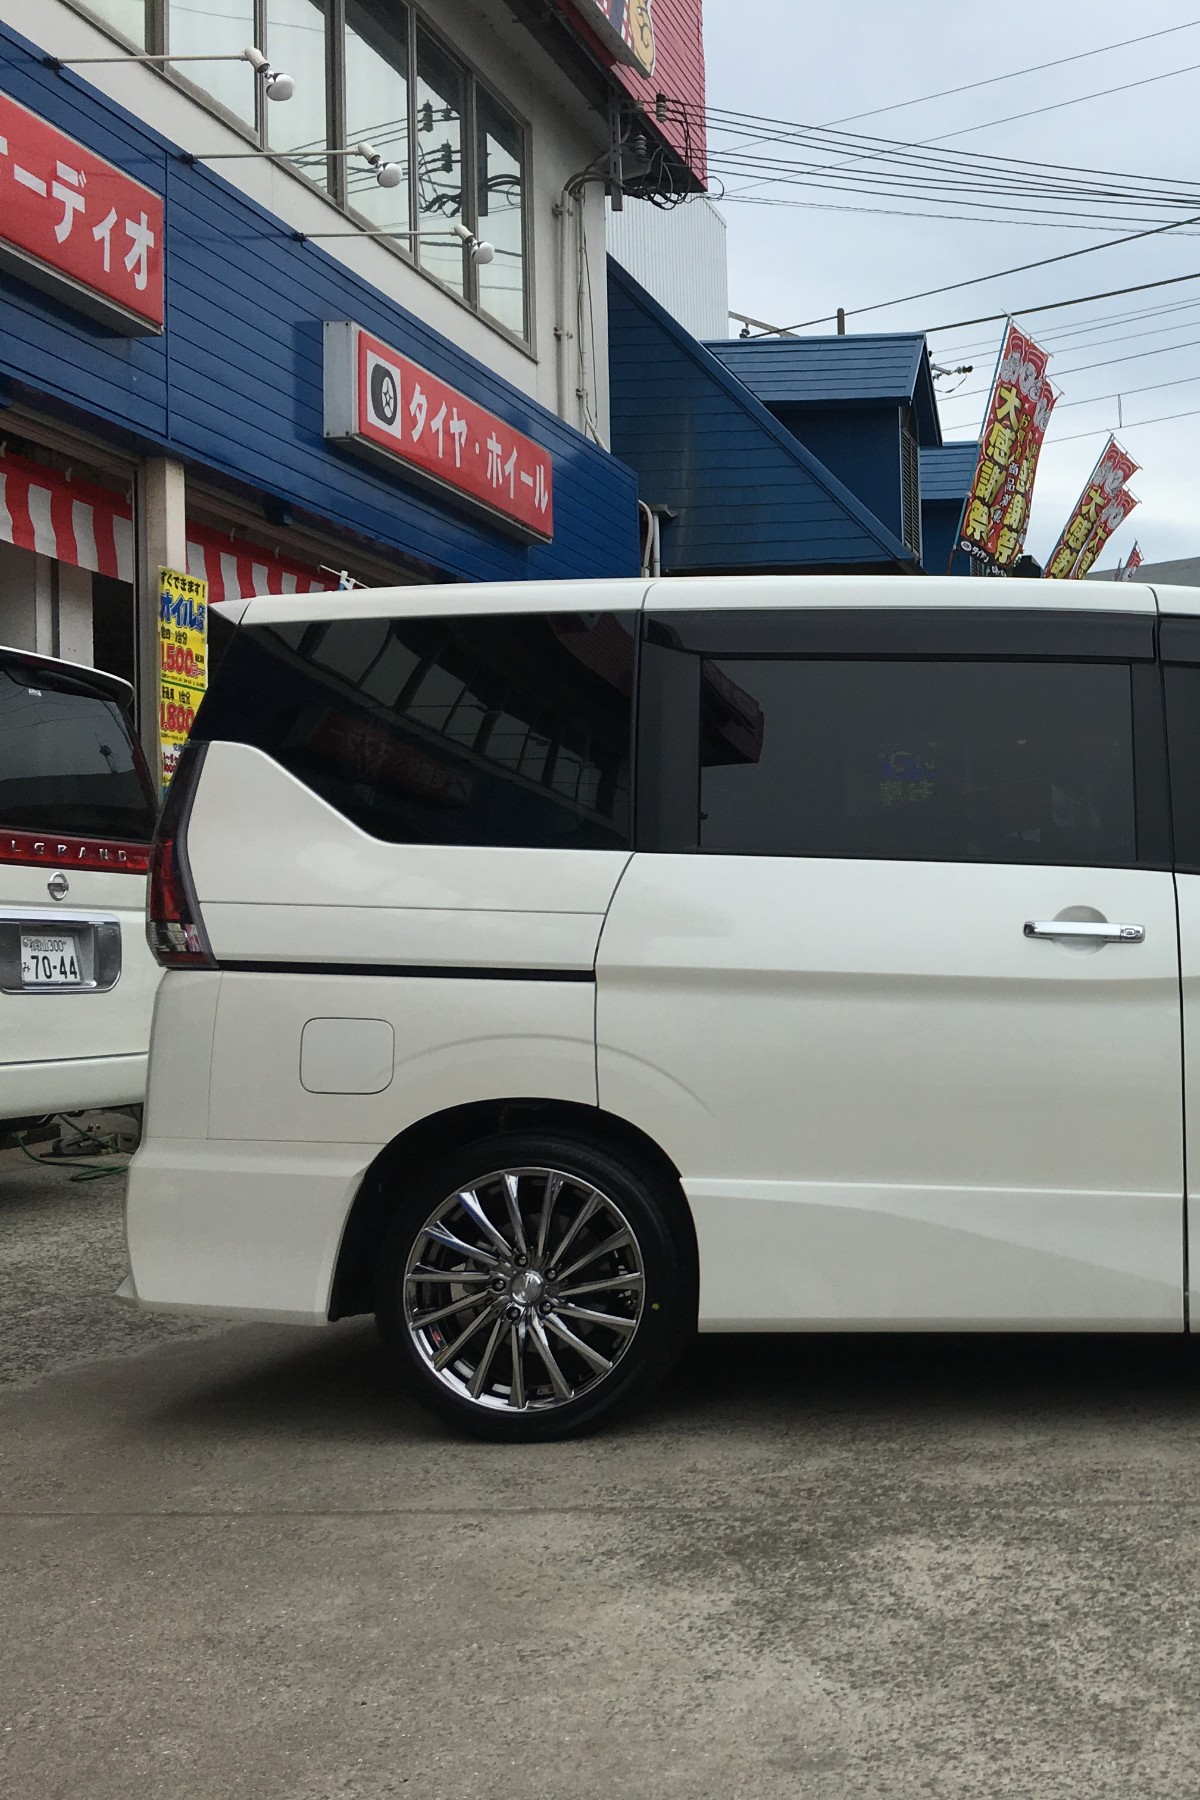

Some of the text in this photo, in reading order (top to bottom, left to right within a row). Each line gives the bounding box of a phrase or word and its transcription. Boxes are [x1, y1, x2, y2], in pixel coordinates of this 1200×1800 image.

[0, 135, 155, 291] ーディオ
[409, 382, 549, 514] タイヤ・ホイール
[1050, 487, 1106, 580] 大感謝
[31, 955, 78, 979] 70-44
